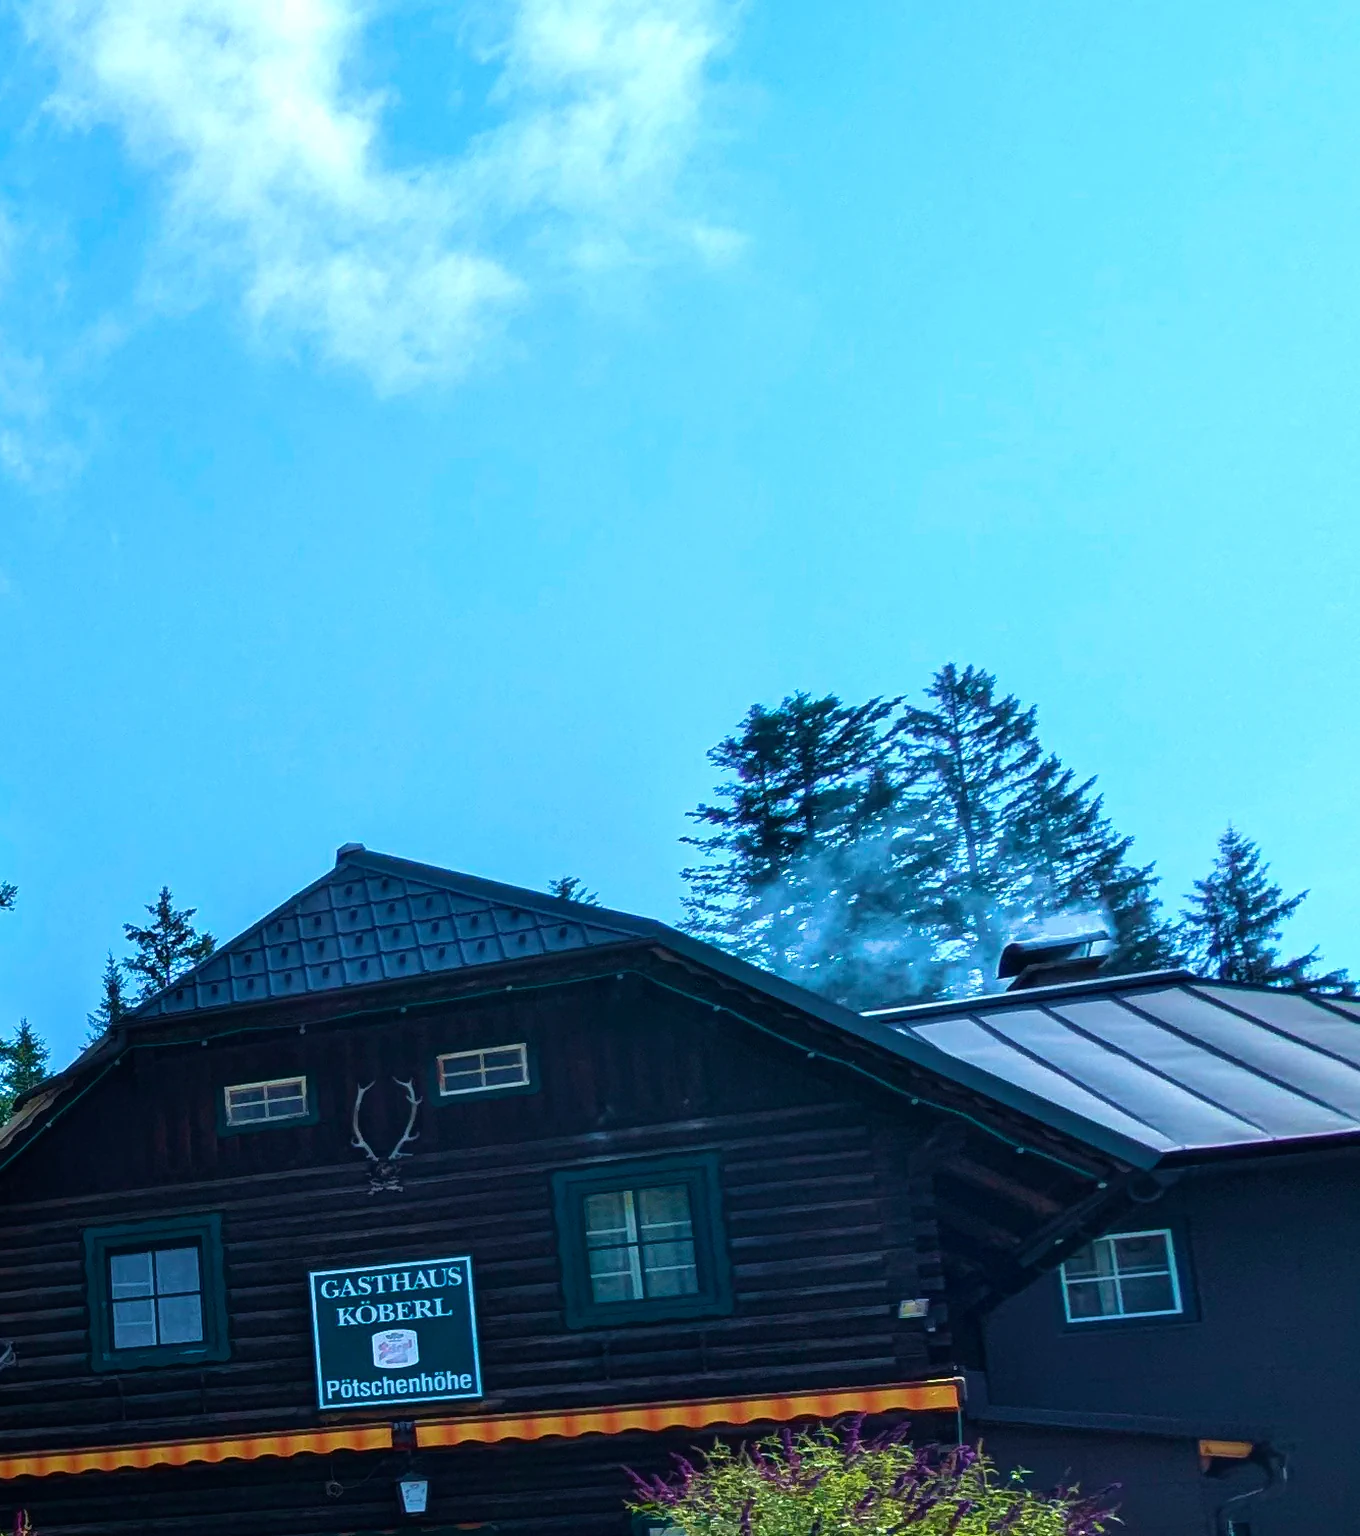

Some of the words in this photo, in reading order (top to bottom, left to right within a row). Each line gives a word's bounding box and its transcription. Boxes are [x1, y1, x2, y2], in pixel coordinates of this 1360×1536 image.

[321, 1267, 463, 1299] GASTHAUS
[336, 1298, 453, 1326] KÖBERL
[326, 1370, 472, 1399] Pötschenhöhe
